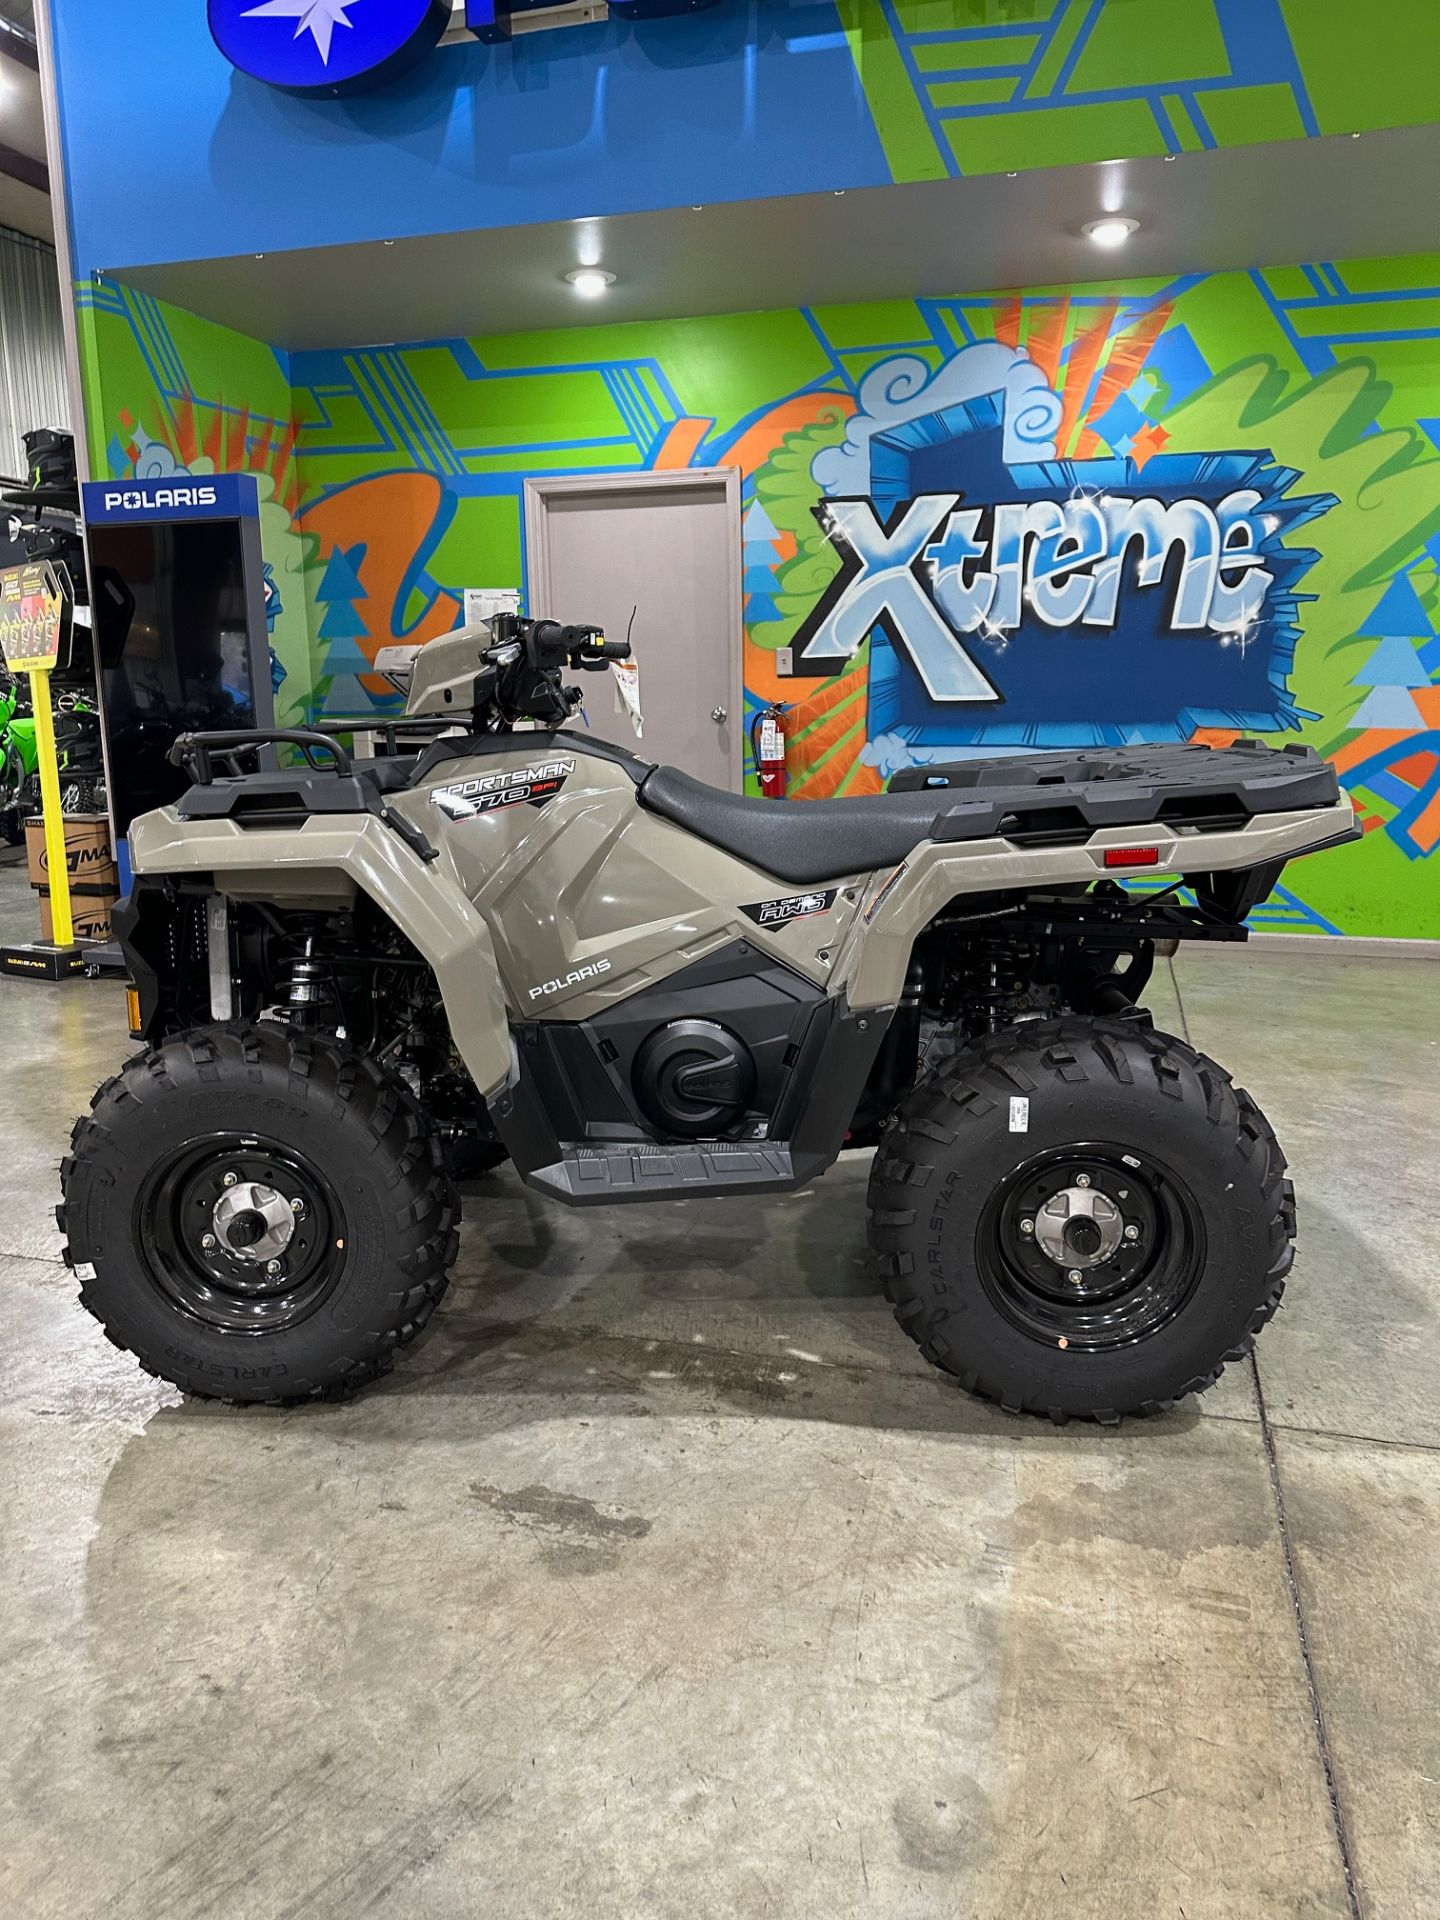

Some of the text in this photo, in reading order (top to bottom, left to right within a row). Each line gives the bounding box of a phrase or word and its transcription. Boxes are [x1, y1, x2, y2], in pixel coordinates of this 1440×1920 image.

[104, 486, 217, 511] POLARIS
[798, 488, 1276, 702] Xtreme
[429, 760, 577, 804] SPORTSMAN
[759, 897, 826, 922] AWD
[528, 958, 612, 1000] POLARIS
[926, 1169, 965, 1297] CARLSTAR
